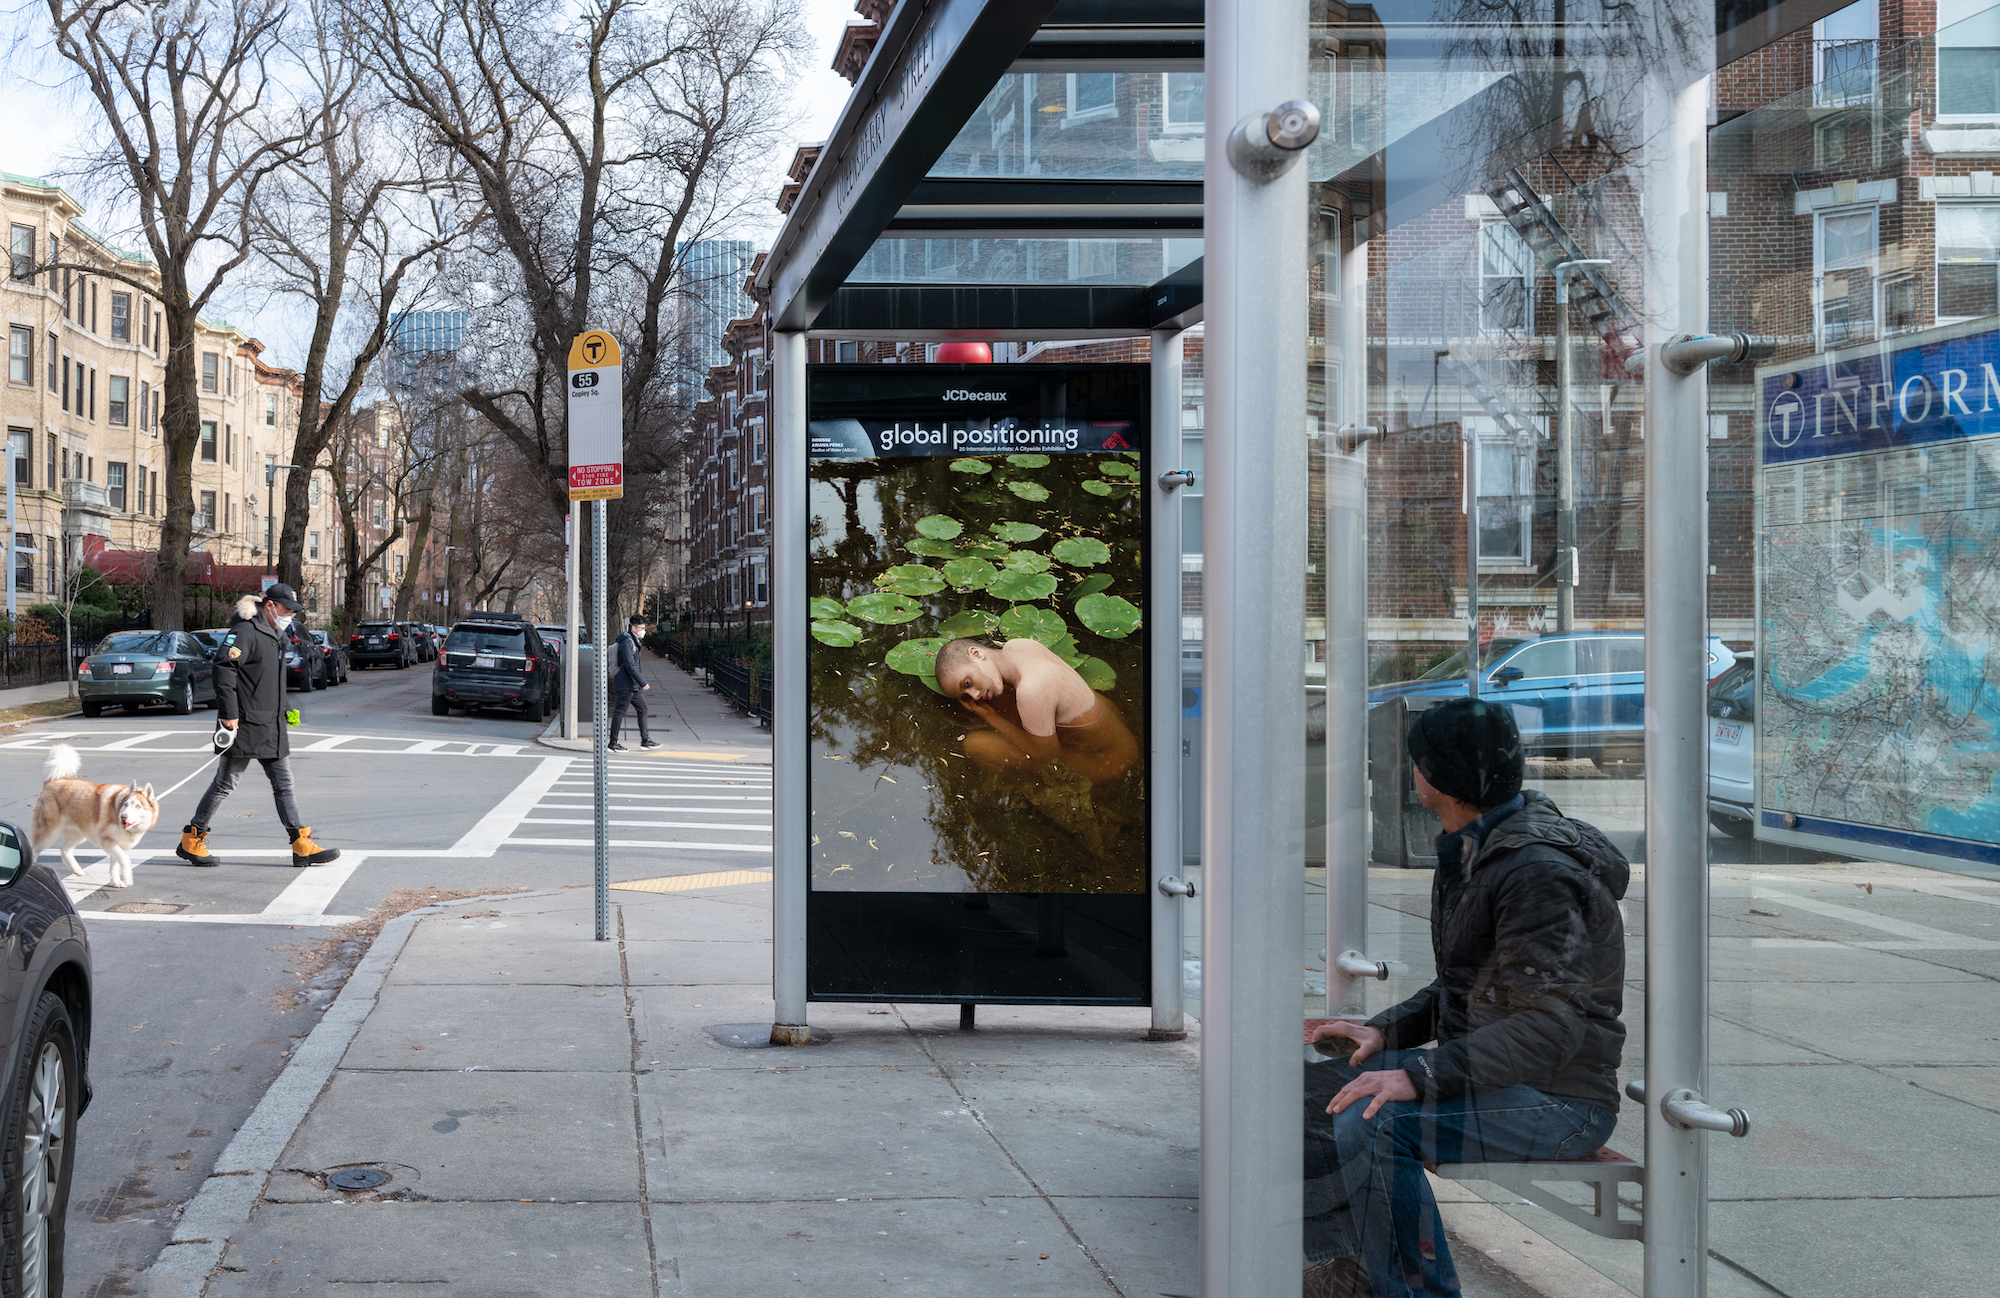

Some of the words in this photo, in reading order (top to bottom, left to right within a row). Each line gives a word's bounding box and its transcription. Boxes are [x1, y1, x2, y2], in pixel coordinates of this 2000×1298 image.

[836, 101, 887, 215] QUEENSBERRY
[900, 18, 937, 111] STREET
[587, 342, 602, 358] T
[579, 374, 592, 387] 55
[572, 390, 590, 398] Copley
[591, 388, 600, 396] Sq.
[942, 389, 1007, 401] JCDecaux
[880, 422, 948, 450] global
[953, 423, 1079, 450] positioning
[1101, 431, 1118, 449] PUBLIC
[586, 465, 614, 473] STOPPING
